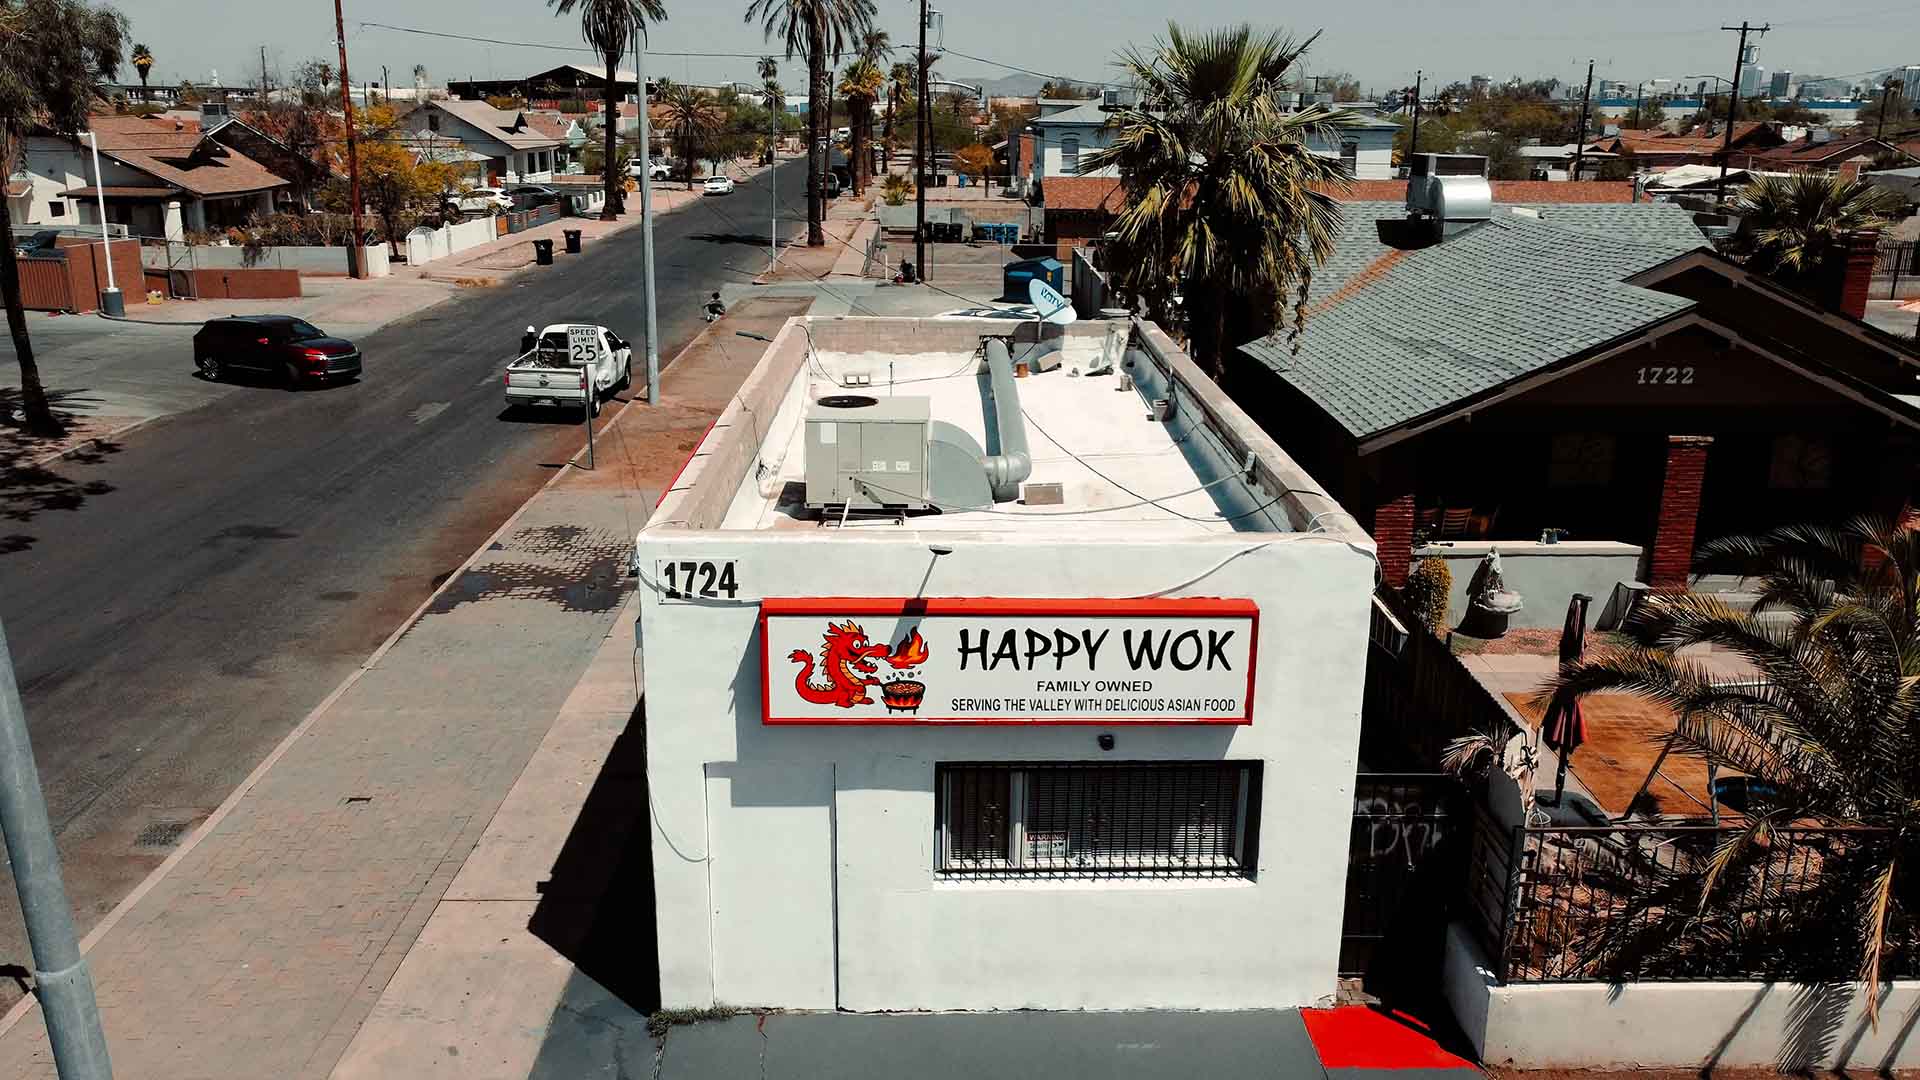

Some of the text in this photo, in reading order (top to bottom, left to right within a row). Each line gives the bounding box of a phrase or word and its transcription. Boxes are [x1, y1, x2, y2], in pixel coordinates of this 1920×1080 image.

[572, 345, 597, 361] 25
[1637, 367, 1695, 385] 1722
[664, 561, 739, 599] 1724
[957, 628, 1236, 671] HAPPY WOK
[1036, 680, 1153, 692] FAMILY OWNED
[951, 698, 1236, 711] SERVING THE VALLEY WITH DELICIOUS ASIAN FOOD
